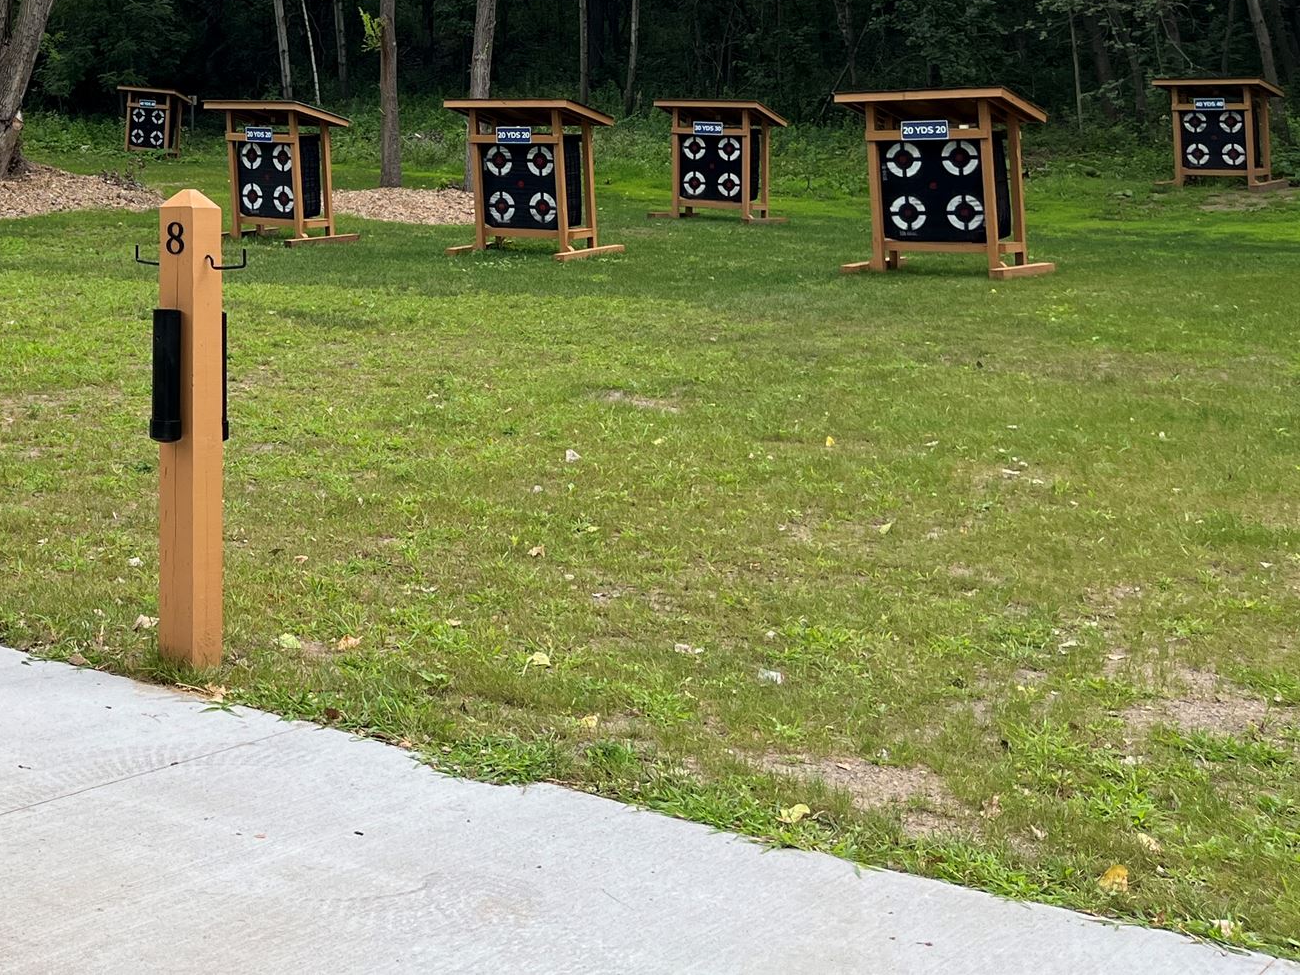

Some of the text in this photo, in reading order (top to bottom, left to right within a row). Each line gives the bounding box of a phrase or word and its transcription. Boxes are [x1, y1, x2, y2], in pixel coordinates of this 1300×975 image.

[903, 125, 946, 134] 20 YDS 20
[166, 221, 185, 255] 8
